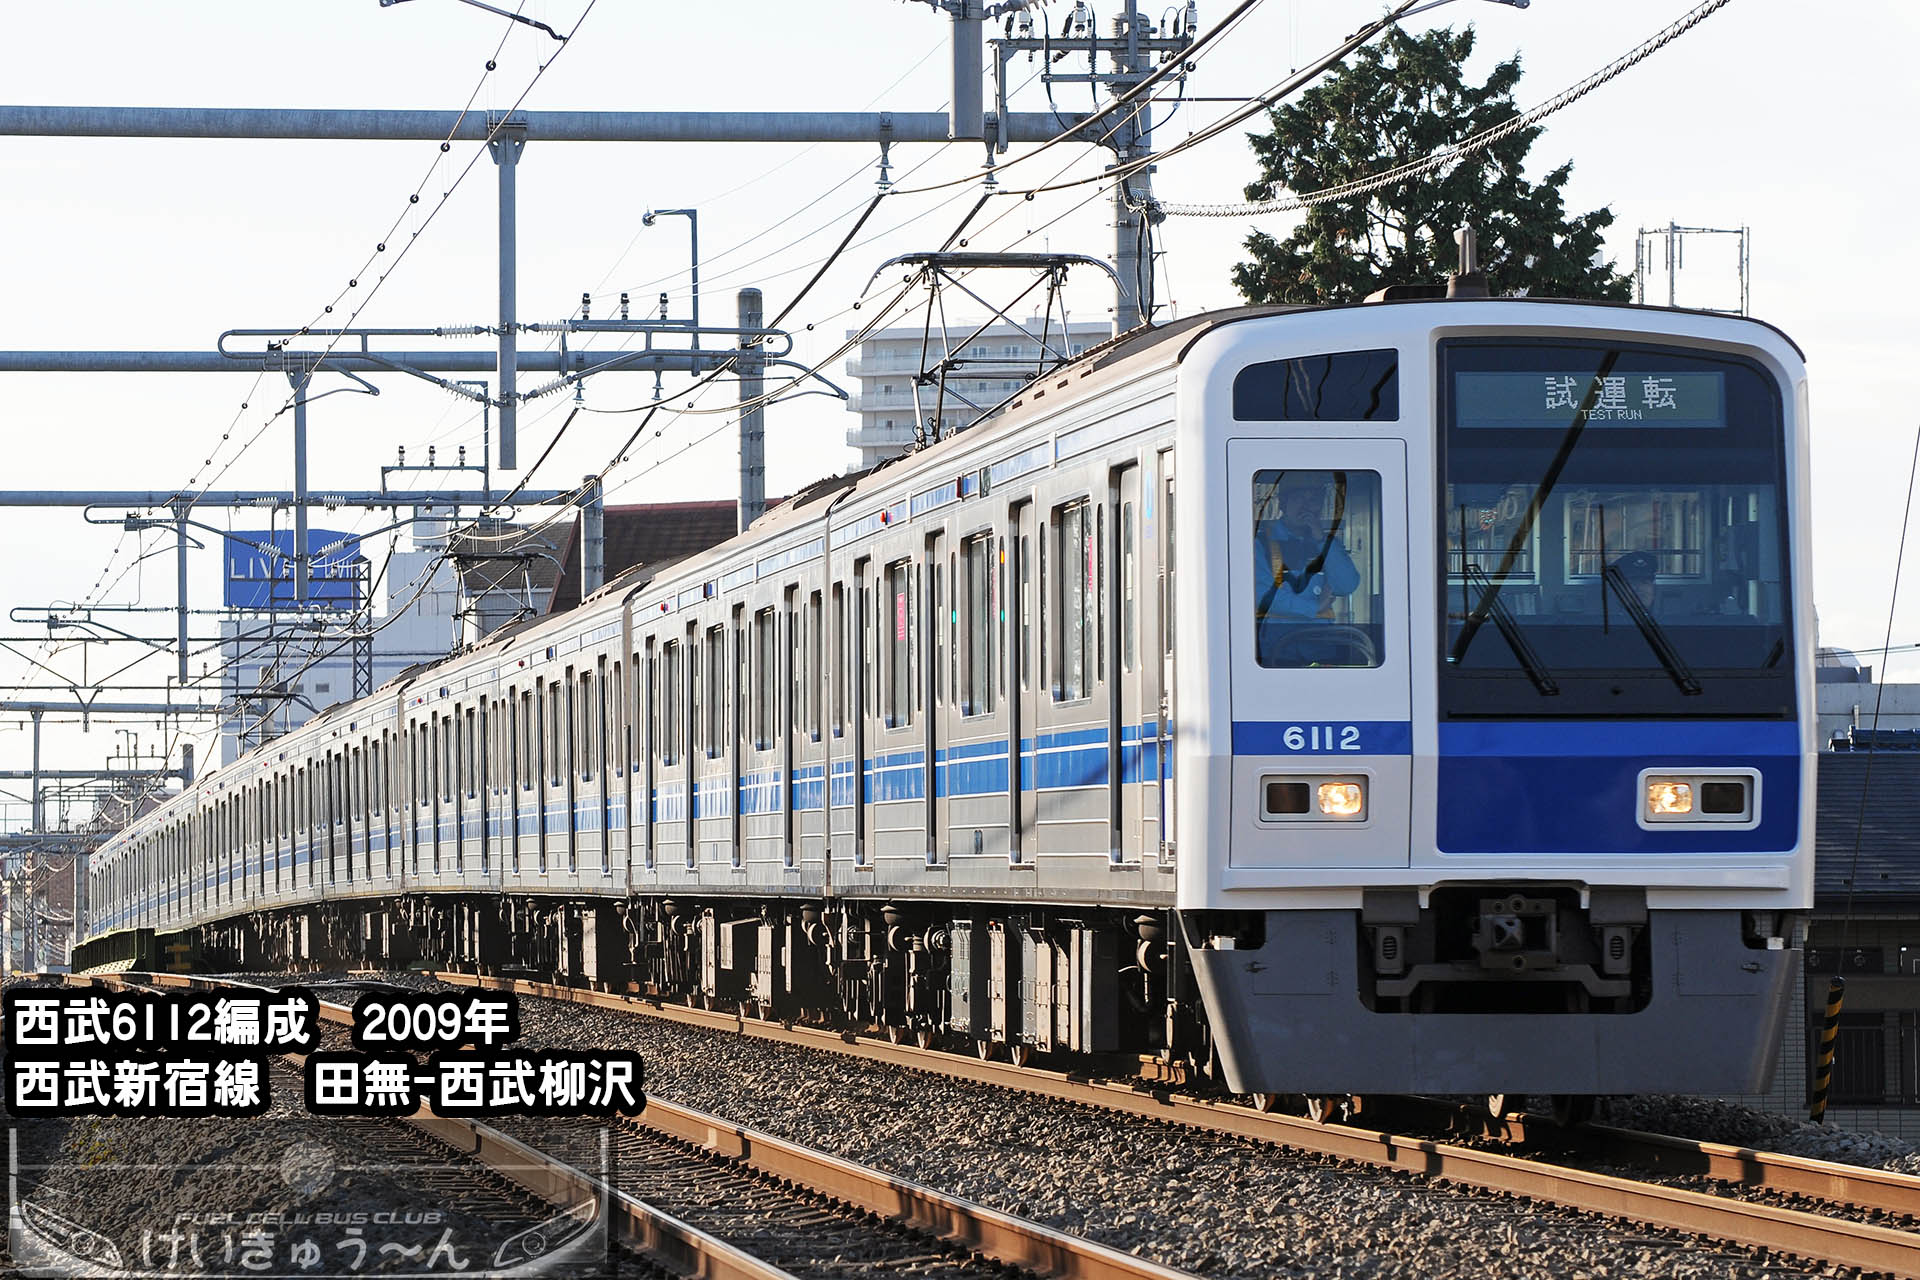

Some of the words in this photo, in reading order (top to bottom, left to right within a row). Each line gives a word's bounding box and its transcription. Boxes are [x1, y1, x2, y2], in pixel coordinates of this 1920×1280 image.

[1545, 375, 1677, 409] 試運転
[1581, 410, 1612, 420] TEST
[1616, 410, 1643, 420] RUN
[1283, 726, 1360, 750] 6112
